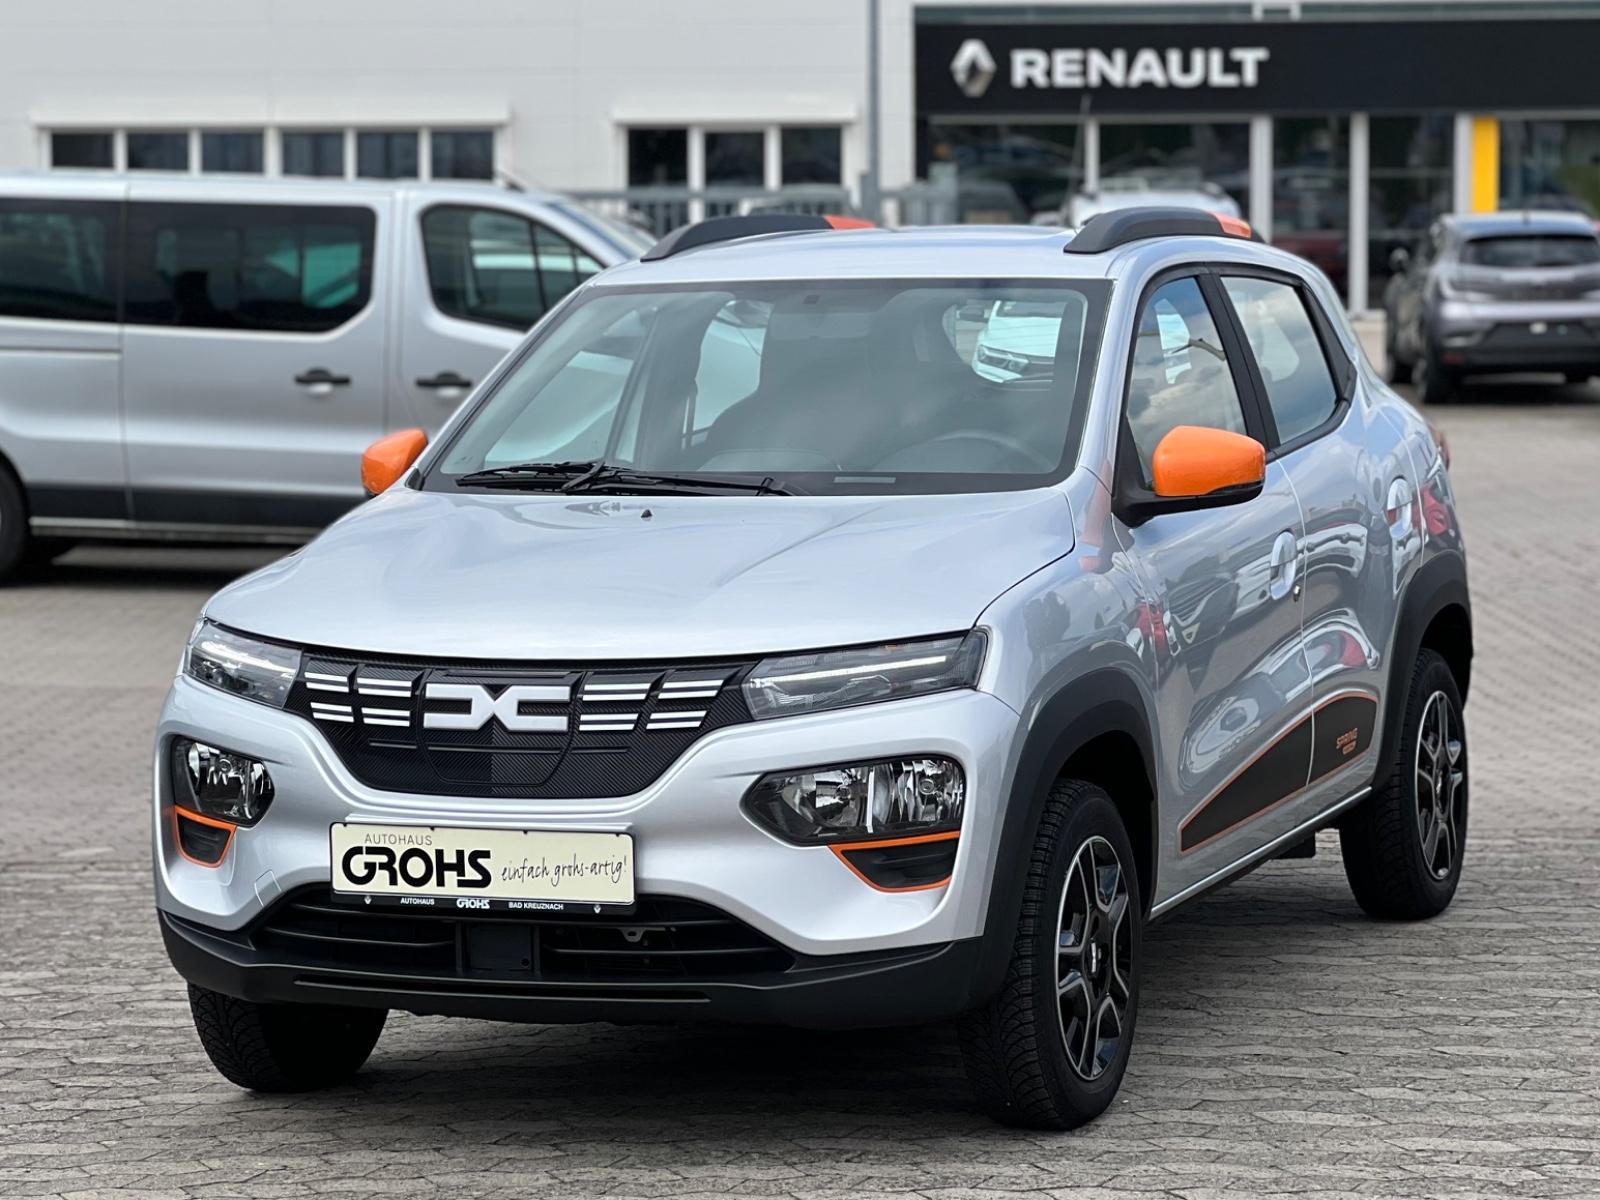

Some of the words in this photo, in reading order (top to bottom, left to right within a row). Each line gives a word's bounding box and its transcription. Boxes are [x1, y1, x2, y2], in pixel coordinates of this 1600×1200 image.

[1010, 48, 1270, 88] RENAULT
[364, 833, 433, 846] AUTOHAUS
[342, 846, 492, 888] GROHS
[501, 856, 550, 883] einfach
[551, 853, 627, 887] grohs-artig!
[400, 897, 435, 906] AUTOHAUS
[456, 898, 490, 909] GROHS
[508, 901, 523, 909] BAD
[523, 902, 564, 910] KREUZNACH
